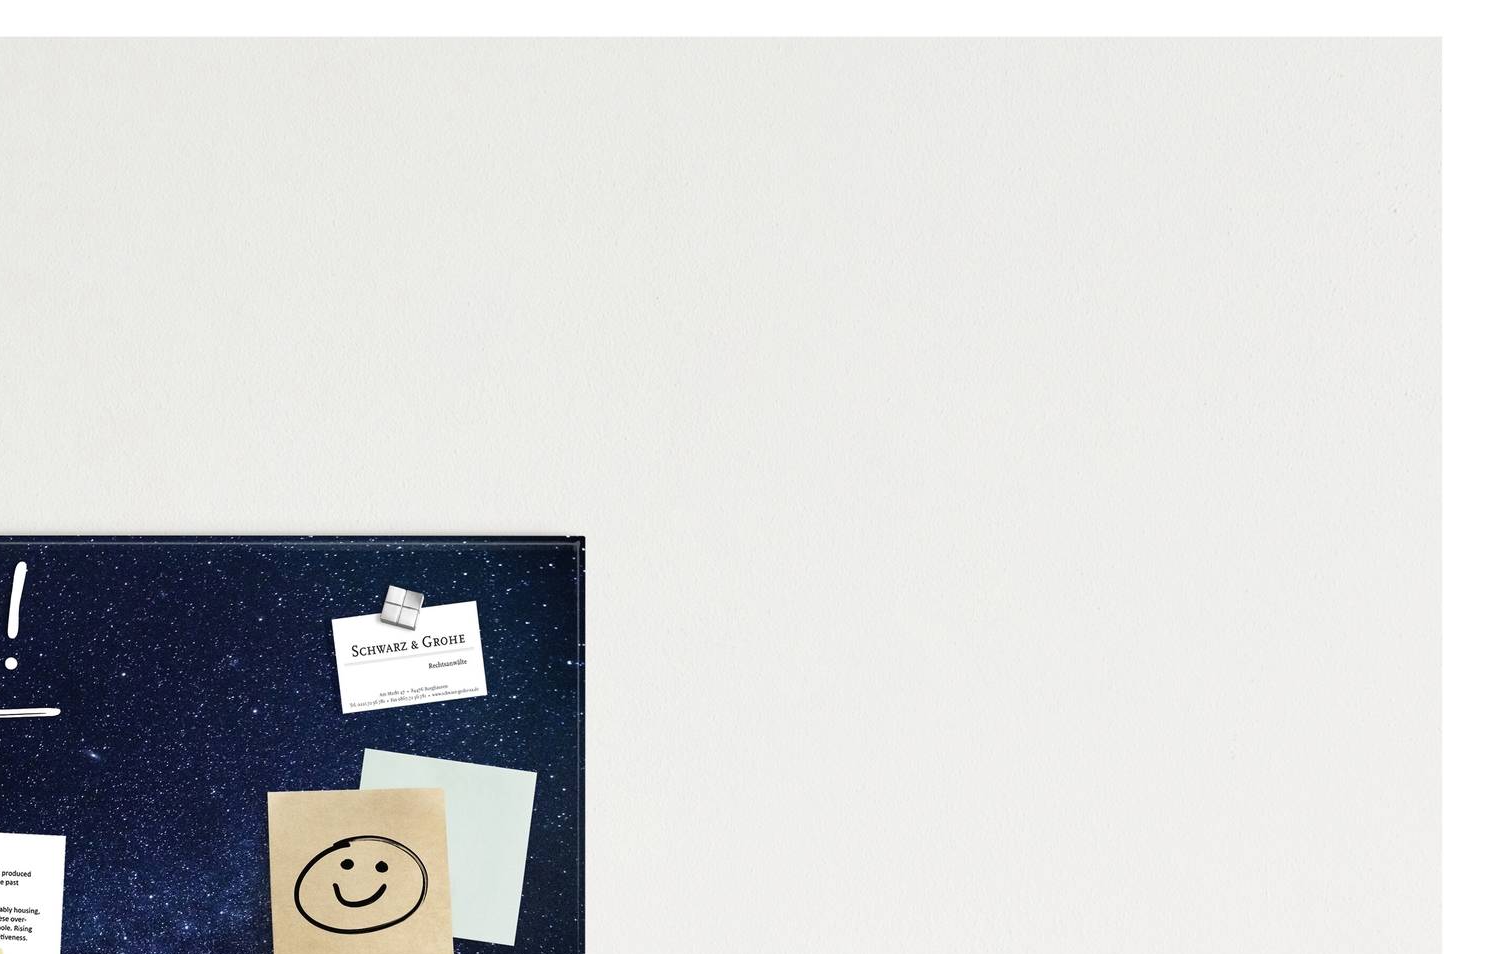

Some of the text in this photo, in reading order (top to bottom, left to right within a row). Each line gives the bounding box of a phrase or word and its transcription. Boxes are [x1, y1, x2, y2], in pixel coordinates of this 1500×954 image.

[352, 634, 466, 658] SCHWARZ & GROHE
[428, 658, 468, 669] Rechtsanwälte
[13, 906, 40, 915] housing,
[14, 925, 33, 934] Rising
